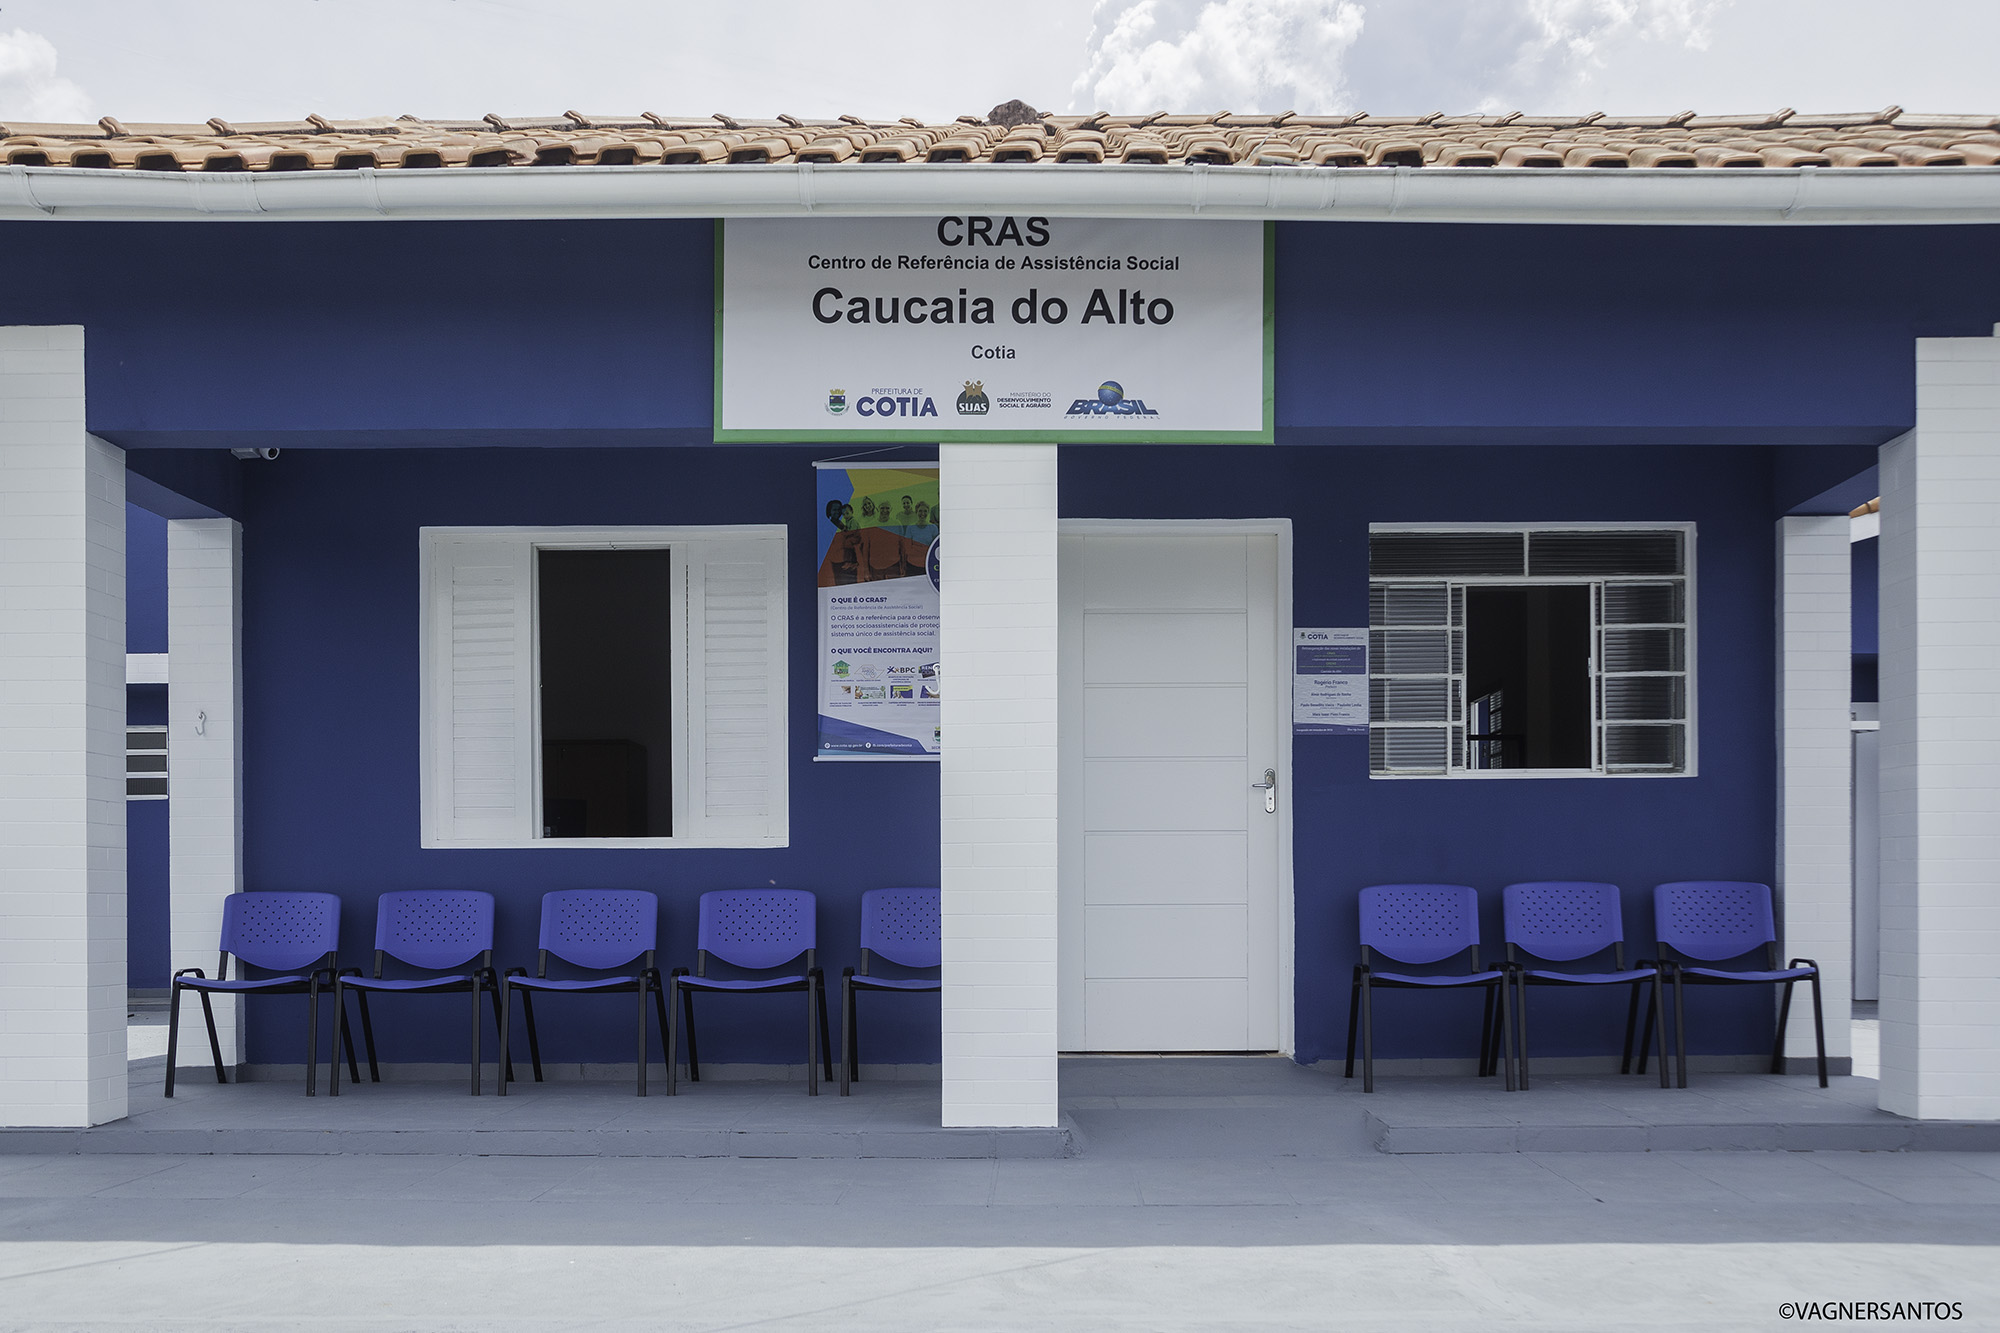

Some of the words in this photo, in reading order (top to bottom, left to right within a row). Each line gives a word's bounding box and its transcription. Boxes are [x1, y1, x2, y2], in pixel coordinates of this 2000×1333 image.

[937, 216, 1050, 247] CRAS
[808, 254, 867, 271] Centro
[871, 254, 893, 271] de
[897, 254, 990, 271] Referência
[994, 254, 1016, 271] de
[1020, 254, 1121, 271] Assistência
[1126, 254, 1180, 271] Social
[812, 287, 996, 325] Caucaia
[1011, 287, 1069, 325] do
[1081, 287, 1175, 325] Alto
[971, 344, 1016, 360] Cotia
[856, 397, 938, 417] COTIA
[958, 402, 987, 412] SUAS
[1066, 400, 1158, 415] BRASIL
